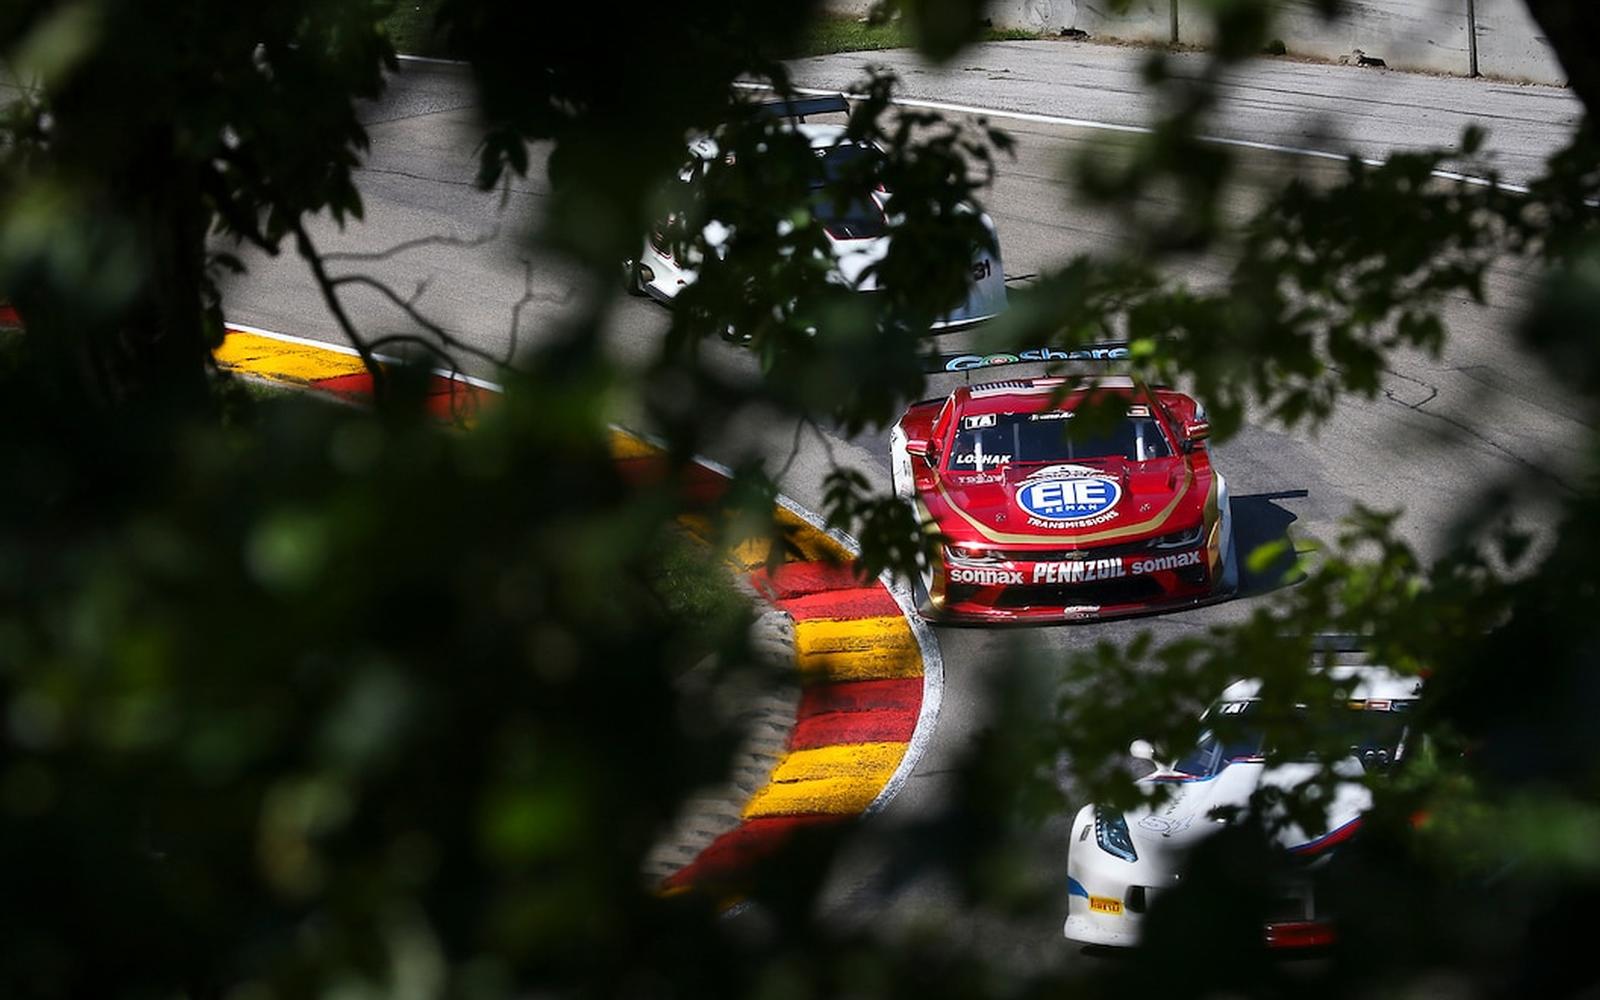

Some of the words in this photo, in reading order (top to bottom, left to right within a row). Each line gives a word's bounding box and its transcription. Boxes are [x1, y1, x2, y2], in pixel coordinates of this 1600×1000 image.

[1030, 481, 1107, 509] EIE
[1027, 510, 1119, 529] TRANSMISSIONS
[1045, 504, 1097, 514] REMAN
[1032, 557, 1127, 584] PENNZOIL
[1131, 550, 1201, 575] sonnax
[950, 568, 1024, 584] sonnax
